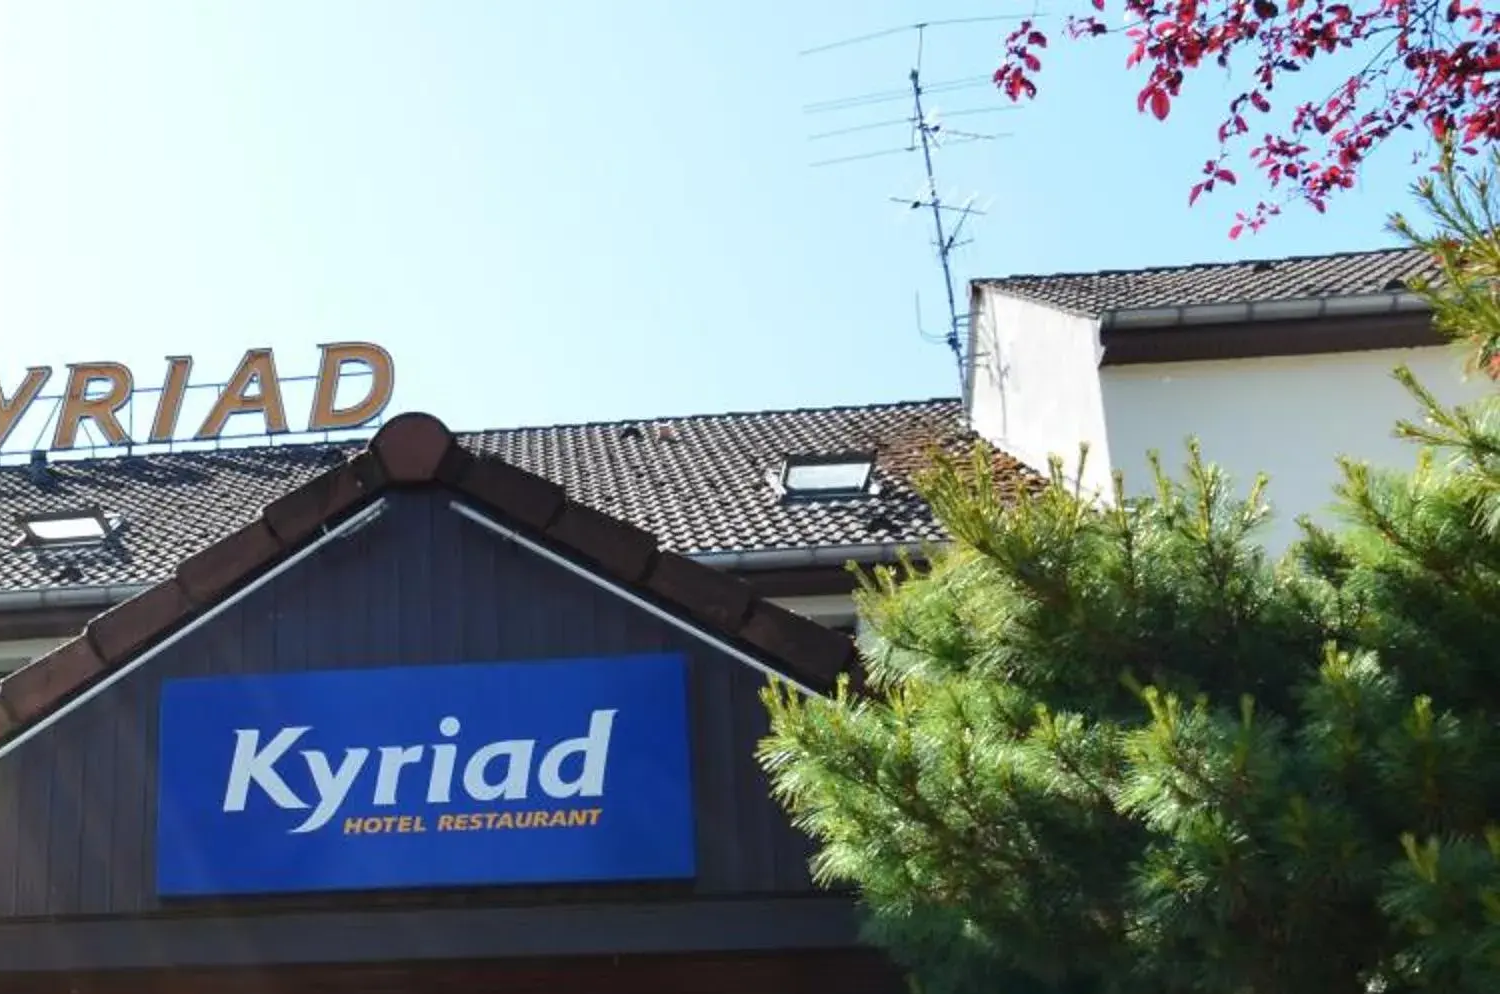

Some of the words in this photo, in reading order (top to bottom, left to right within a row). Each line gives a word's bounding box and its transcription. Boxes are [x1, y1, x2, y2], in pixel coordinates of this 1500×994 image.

[223, 709, 619, 834] Kyriad
[343, 814, 427, 835] HOTEL
[437, 808, 604, 832] RESTAURANT
